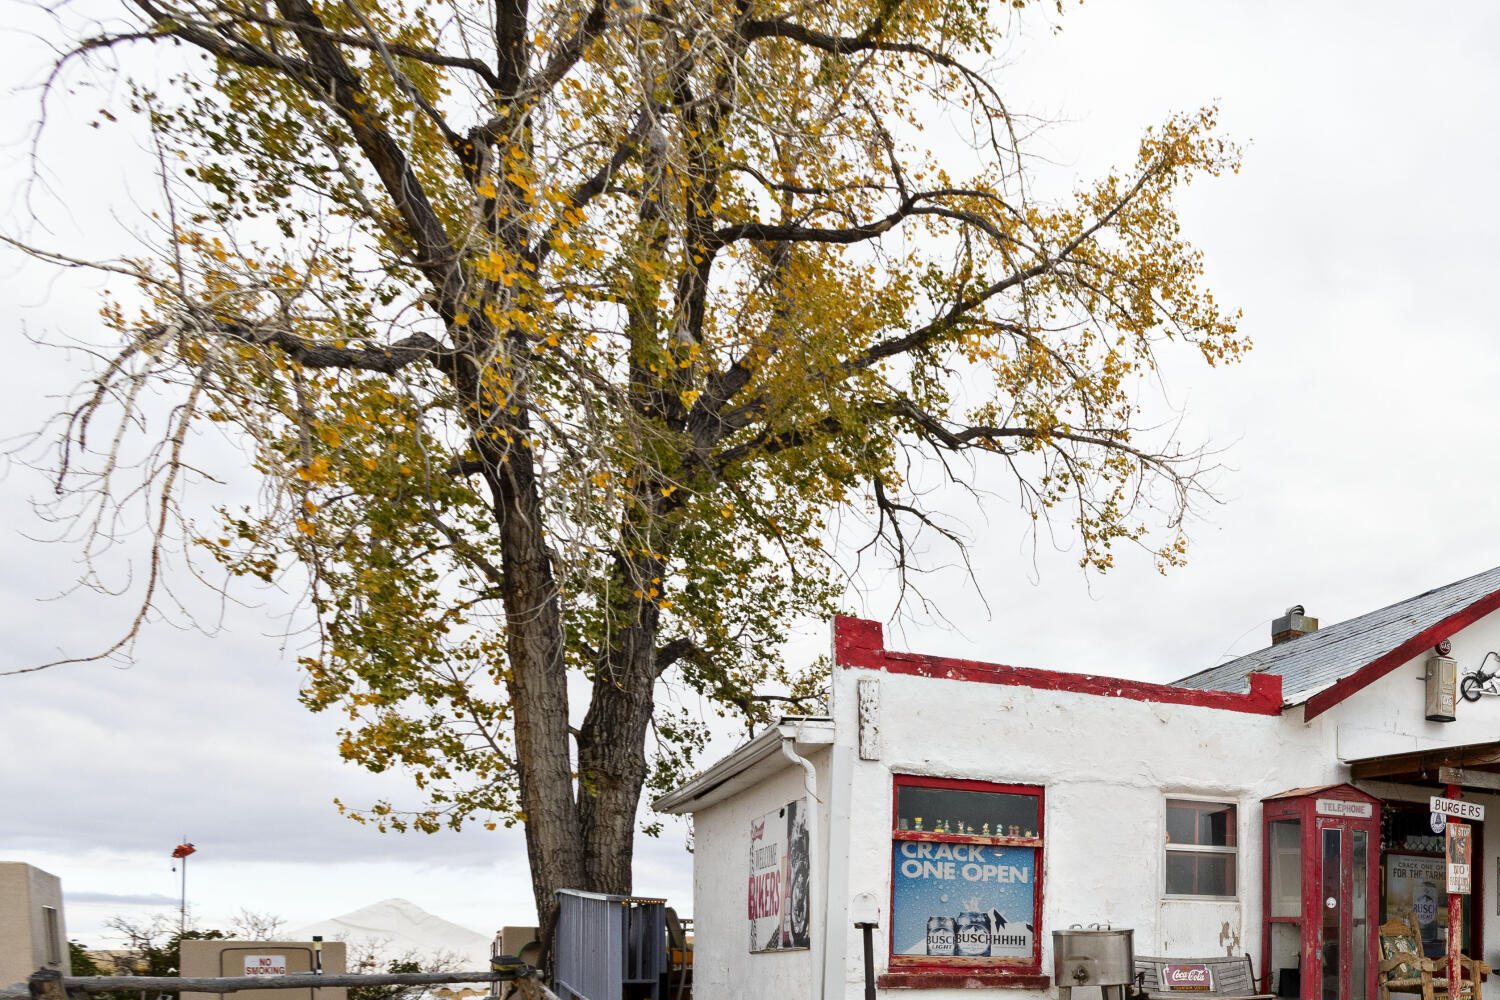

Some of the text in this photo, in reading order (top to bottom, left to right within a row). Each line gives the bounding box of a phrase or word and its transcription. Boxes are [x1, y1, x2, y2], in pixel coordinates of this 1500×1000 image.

[1323, 802, 1366, 815] TELEPHONE
[1434, 799, 1481, 818] BURGERS
[755, 843, 778, 870] WELCOME
[901, 841, 986, 863] CRACK
[1397, 861, 1419, 869] CRACK
[1453, 865, 1465, 875] NO
[901, 859, 1029, 884] ONE OPEN
[1393, 868, 1446, 880] FOR THE FARM
[748, 869, 781, 921] BIKERS
[259, 958, 272, 966] NO
[246, 966, 286, 975] SMOKING
[1172, 969, 1205, 981] Coca-Cola
